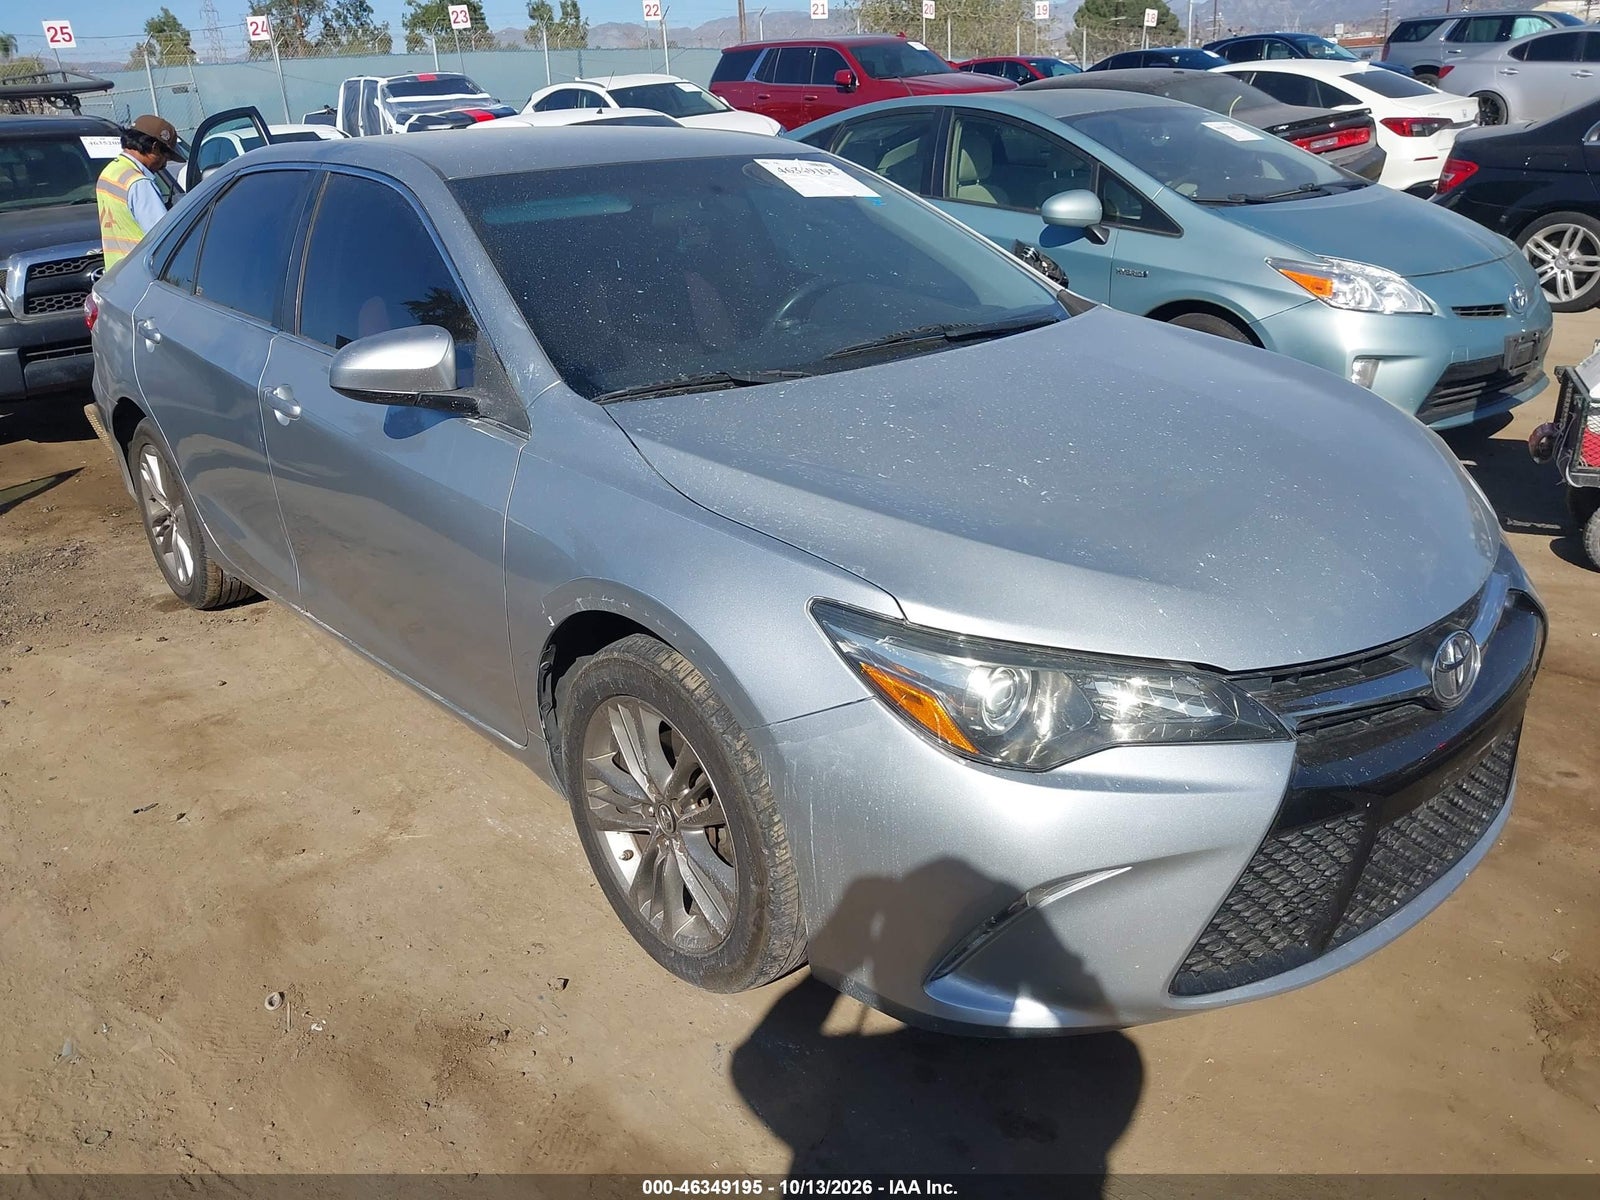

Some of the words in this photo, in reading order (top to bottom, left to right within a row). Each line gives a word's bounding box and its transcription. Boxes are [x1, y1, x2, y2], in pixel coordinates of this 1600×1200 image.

[645, 3, 660, 17] 22
[812, 3, 826, 15] 21
[924, 3, 934, 15] 20
[1036, 4, 1048, 16] 19
[451, 9, 469, 24] 23
[1145, 12, 1156, 24] 18
[47, 26, 73, 43] 25
[250, 20, 268, 36] 24
